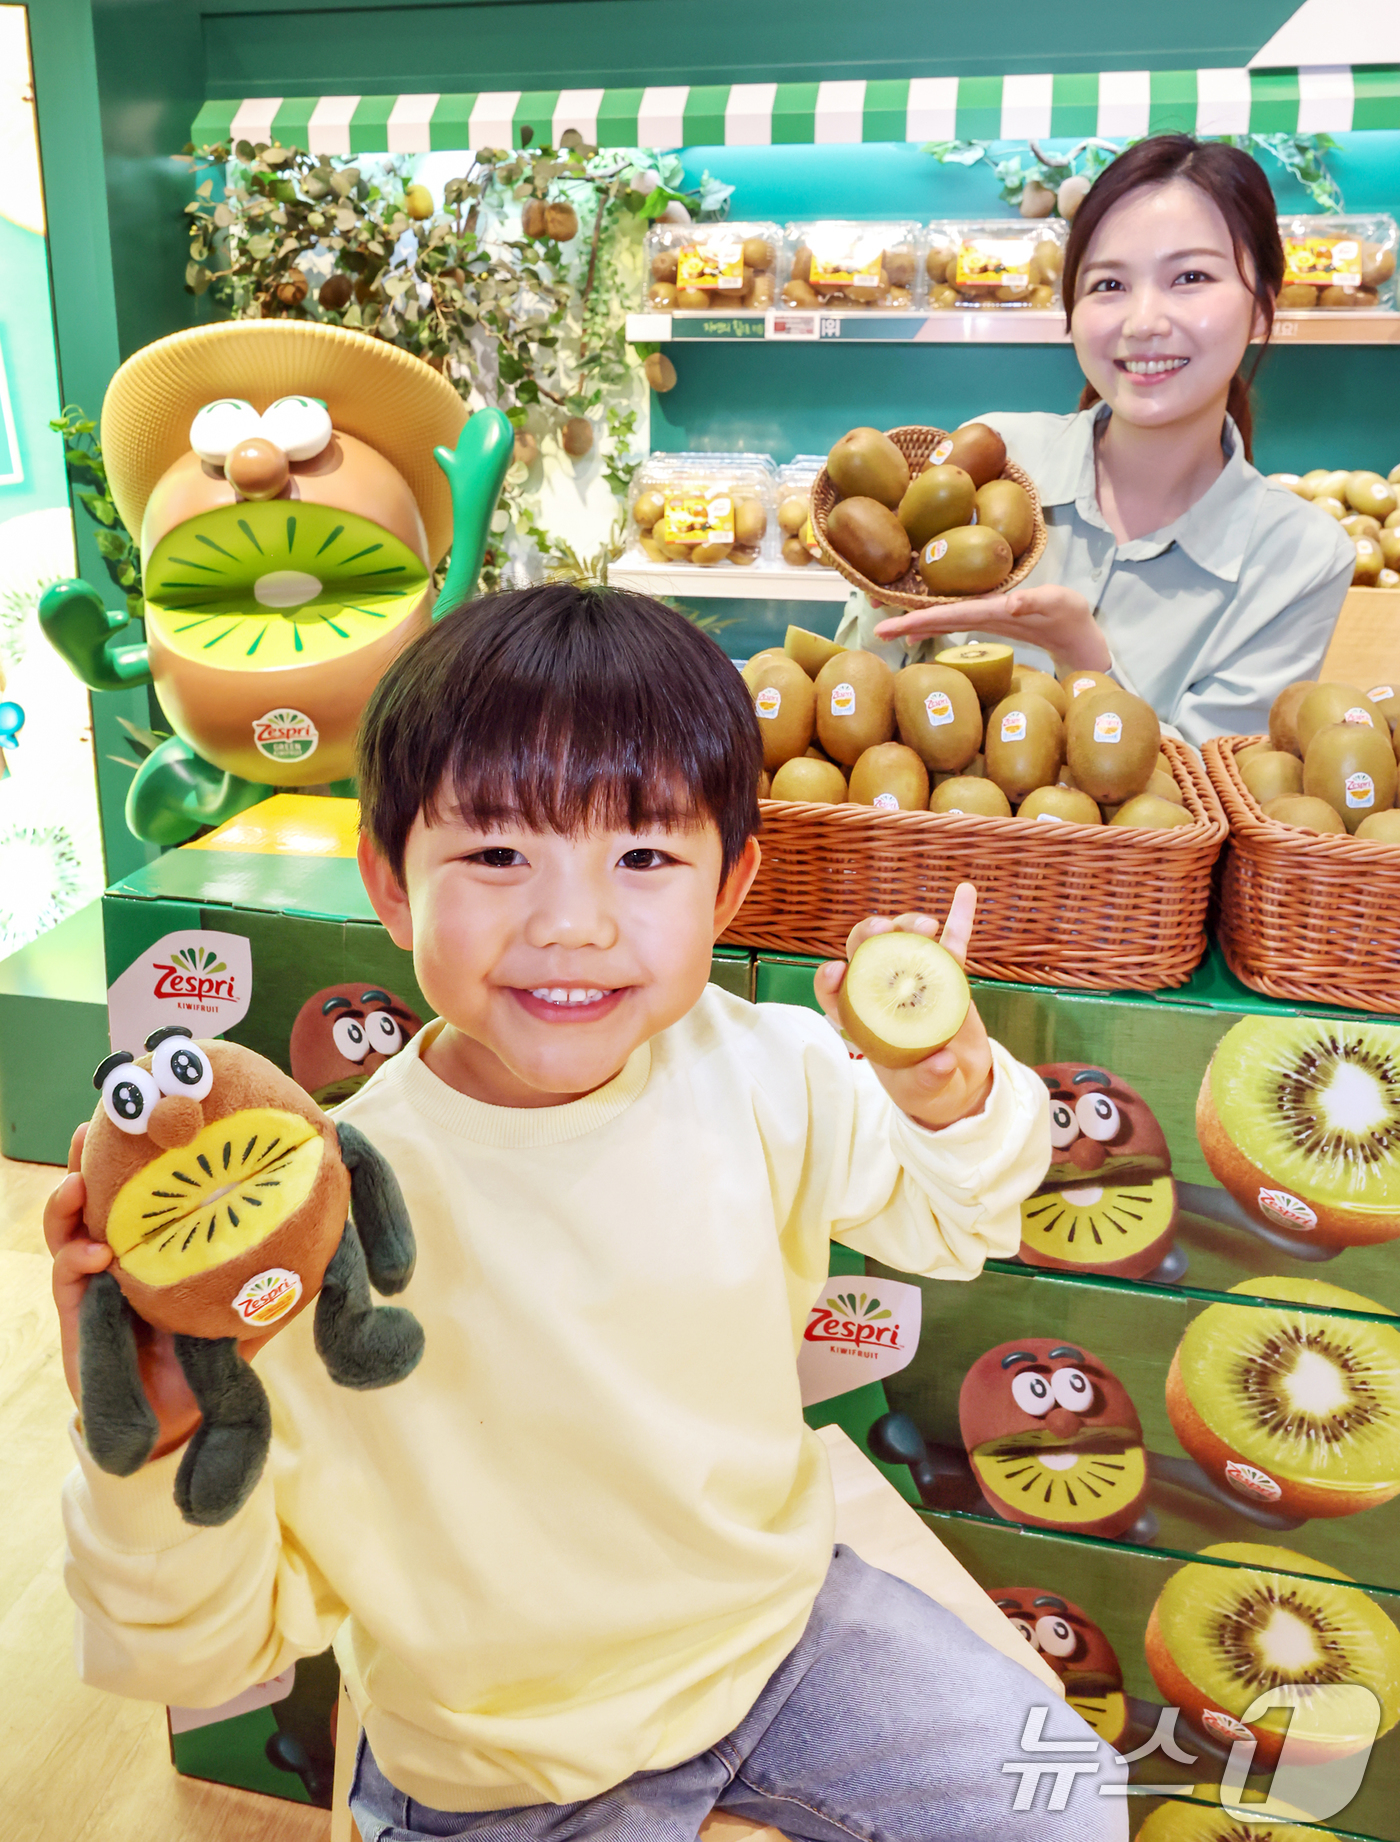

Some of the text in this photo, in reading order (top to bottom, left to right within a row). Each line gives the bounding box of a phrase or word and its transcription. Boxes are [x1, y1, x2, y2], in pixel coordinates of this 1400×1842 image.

[256, 723, 317, 742] Zespri
[152, 962, 238, 1003] Zespri
[177, 1002, 219, 1013] KIWIFRUIT
[1260, 1189, 1314, 1227] Zespri
[237, 1278, 298, 1318] Zespri
[803, 1307, 902, 1350] Zespri
[830, 1345, 879, 1360] KIWIFRUIT
